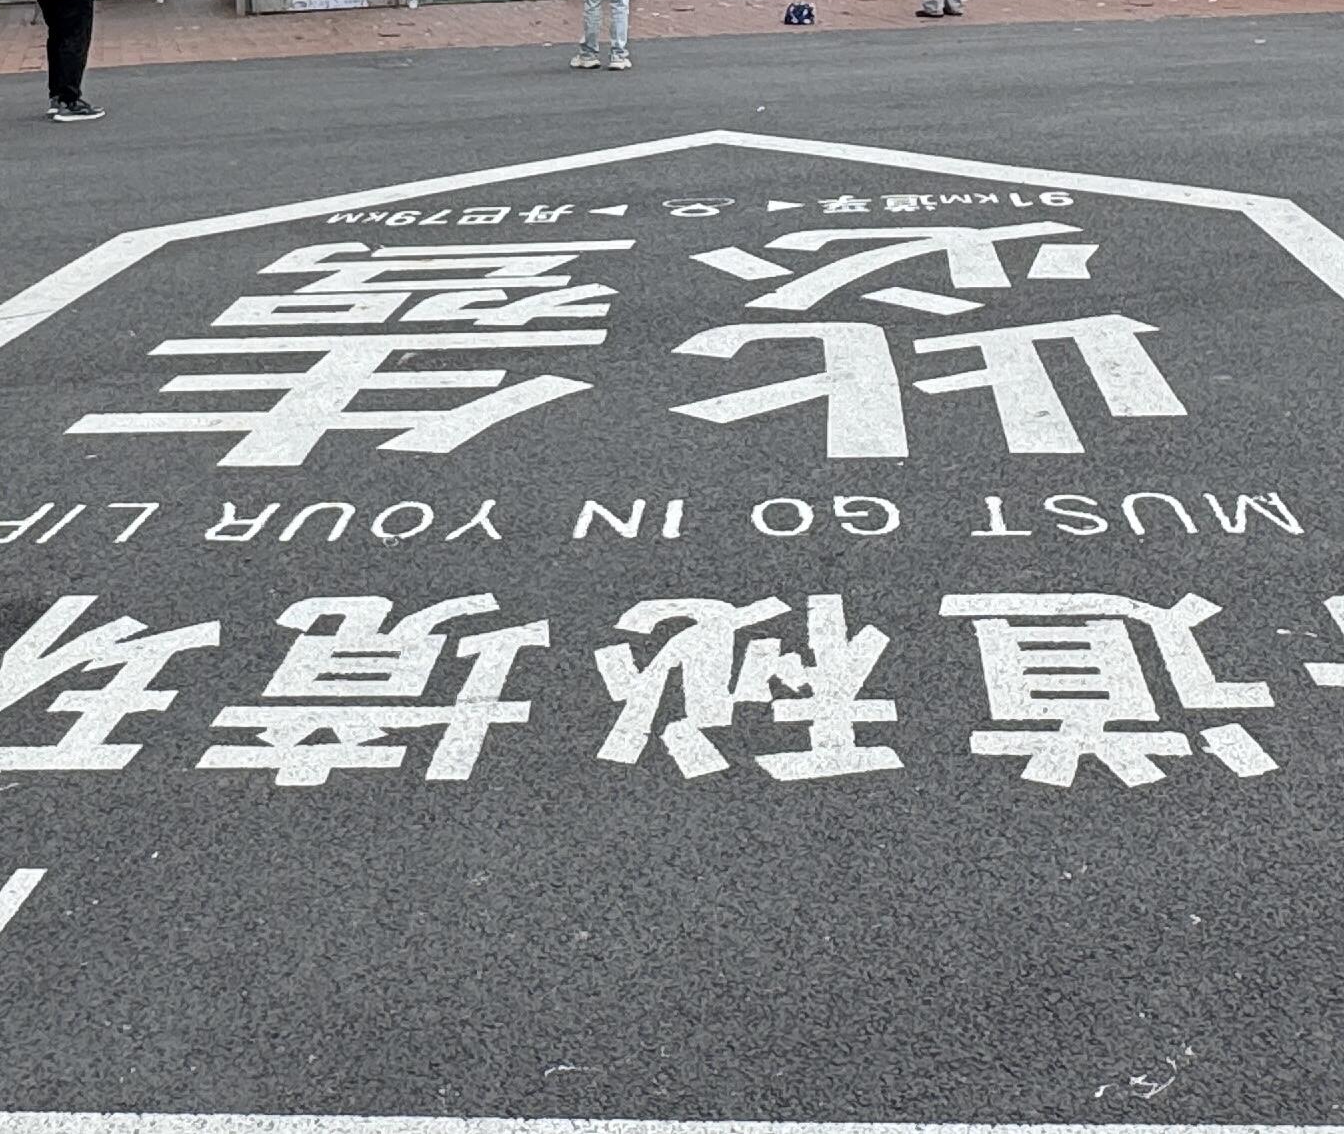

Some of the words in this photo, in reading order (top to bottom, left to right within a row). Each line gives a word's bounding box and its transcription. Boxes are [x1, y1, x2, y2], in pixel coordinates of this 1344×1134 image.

[212, 220, 1100, 327] 必驾
[64, 314, 1187, 469] 此生
[204, 499, 504, 544] YOUR
[572, 499, 684, 539] IN
[751, 496, 901, 537] GO
[971, 492, 1305, 537] MUST
